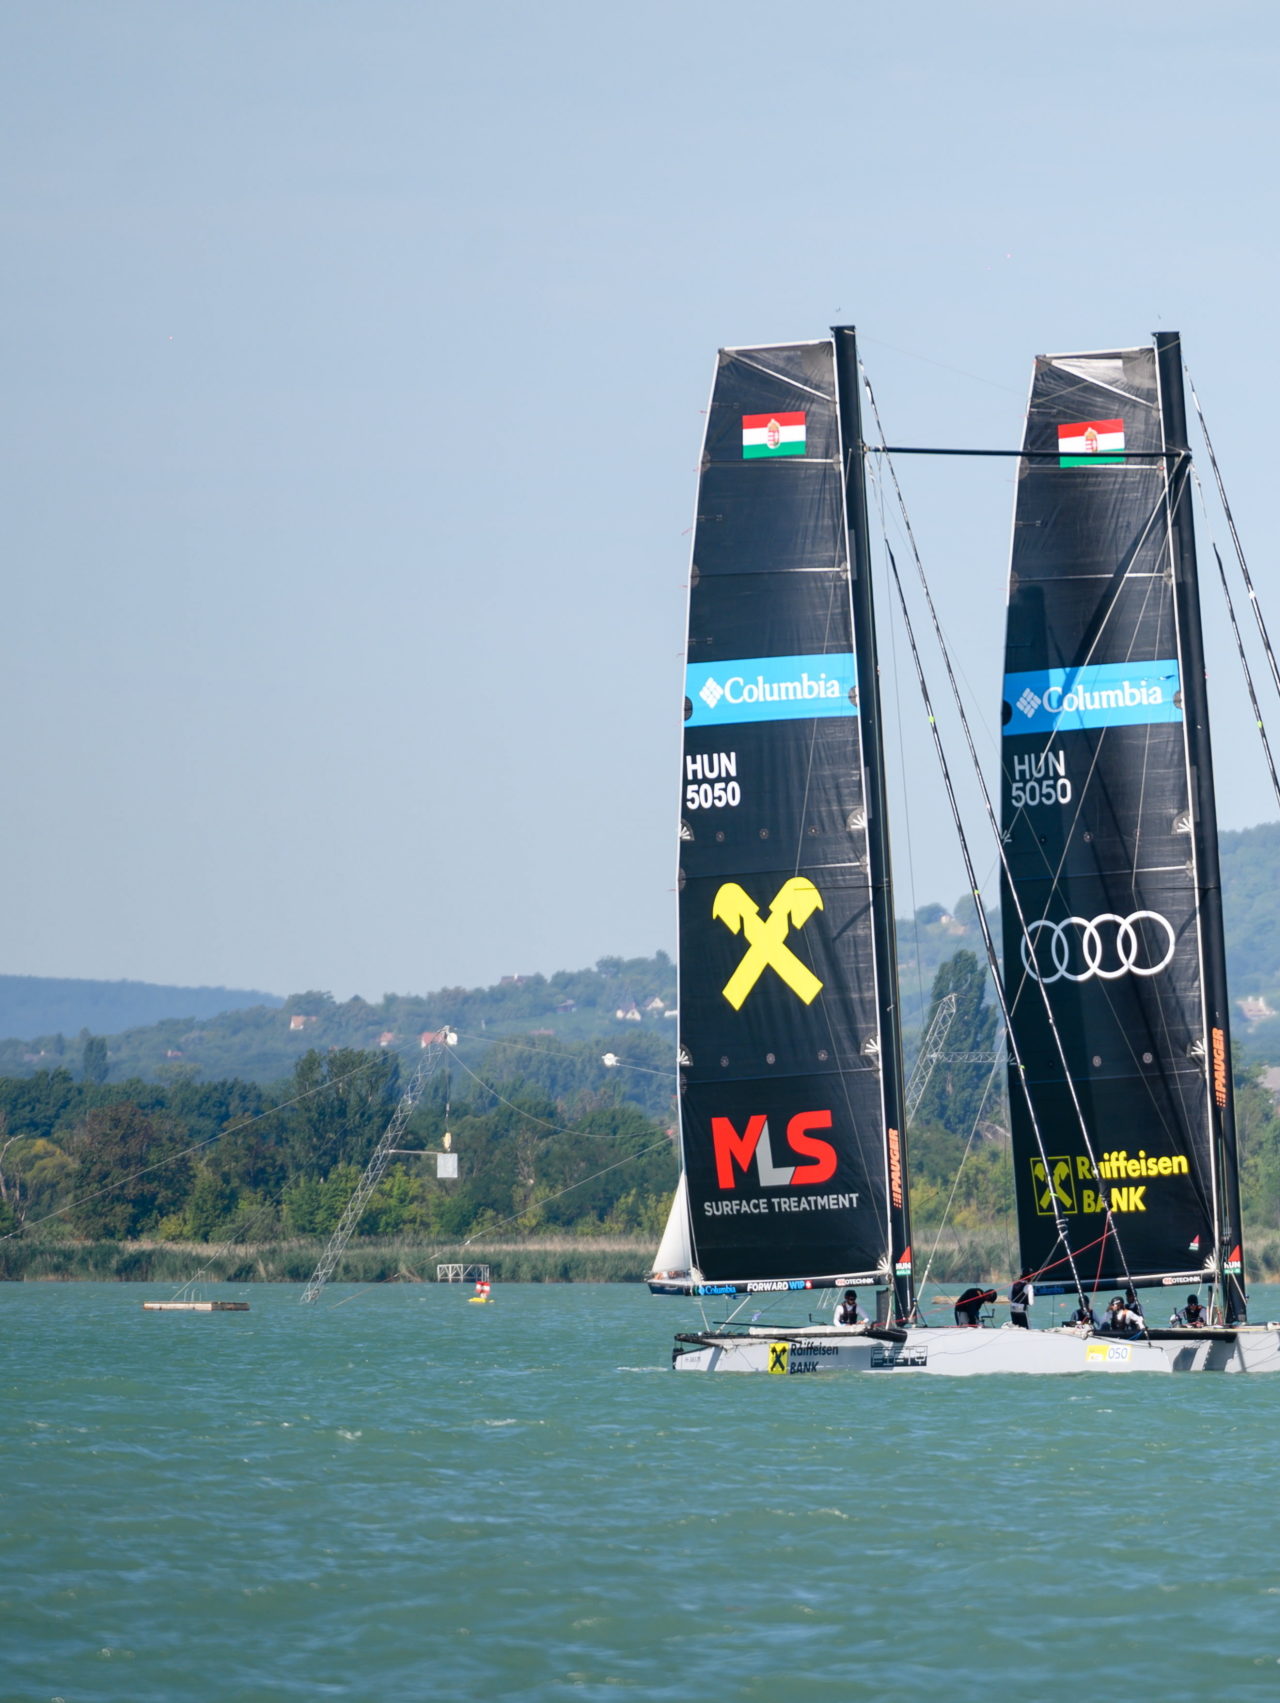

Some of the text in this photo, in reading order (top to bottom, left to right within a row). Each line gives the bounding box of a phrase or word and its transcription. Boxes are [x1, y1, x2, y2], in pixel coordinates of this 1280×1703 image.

[724, 673, 841, 704] Columbia
[1042, 680, 1163, 713] Columbia
[686, 751, 737, 781] HUN
[1013, 750, 1066, 780] HUN
[686, 780, 741, 810] 5050
[1011, 778, 1072, 808] 5050
[1212, 1027, 1227, 1094] PAUGER
[711, 1109, 838, 1189] MLS
[888, 1128, 902, 1194] PAUGER
[1076, 1149, 1189, 1180] Raiffeisen
[704, 1193, 860, 1217] SURFACE TREATMENT
[705, 1284, 737, 1295] Columbia
[746, 1280, 806, 1292] FORWARD WIP
[790, 1341, 839, 1357] Raiffeisen
[1108, 1347, 1128, 1360] 050
[789, 1361, 819, 1375] BANK
